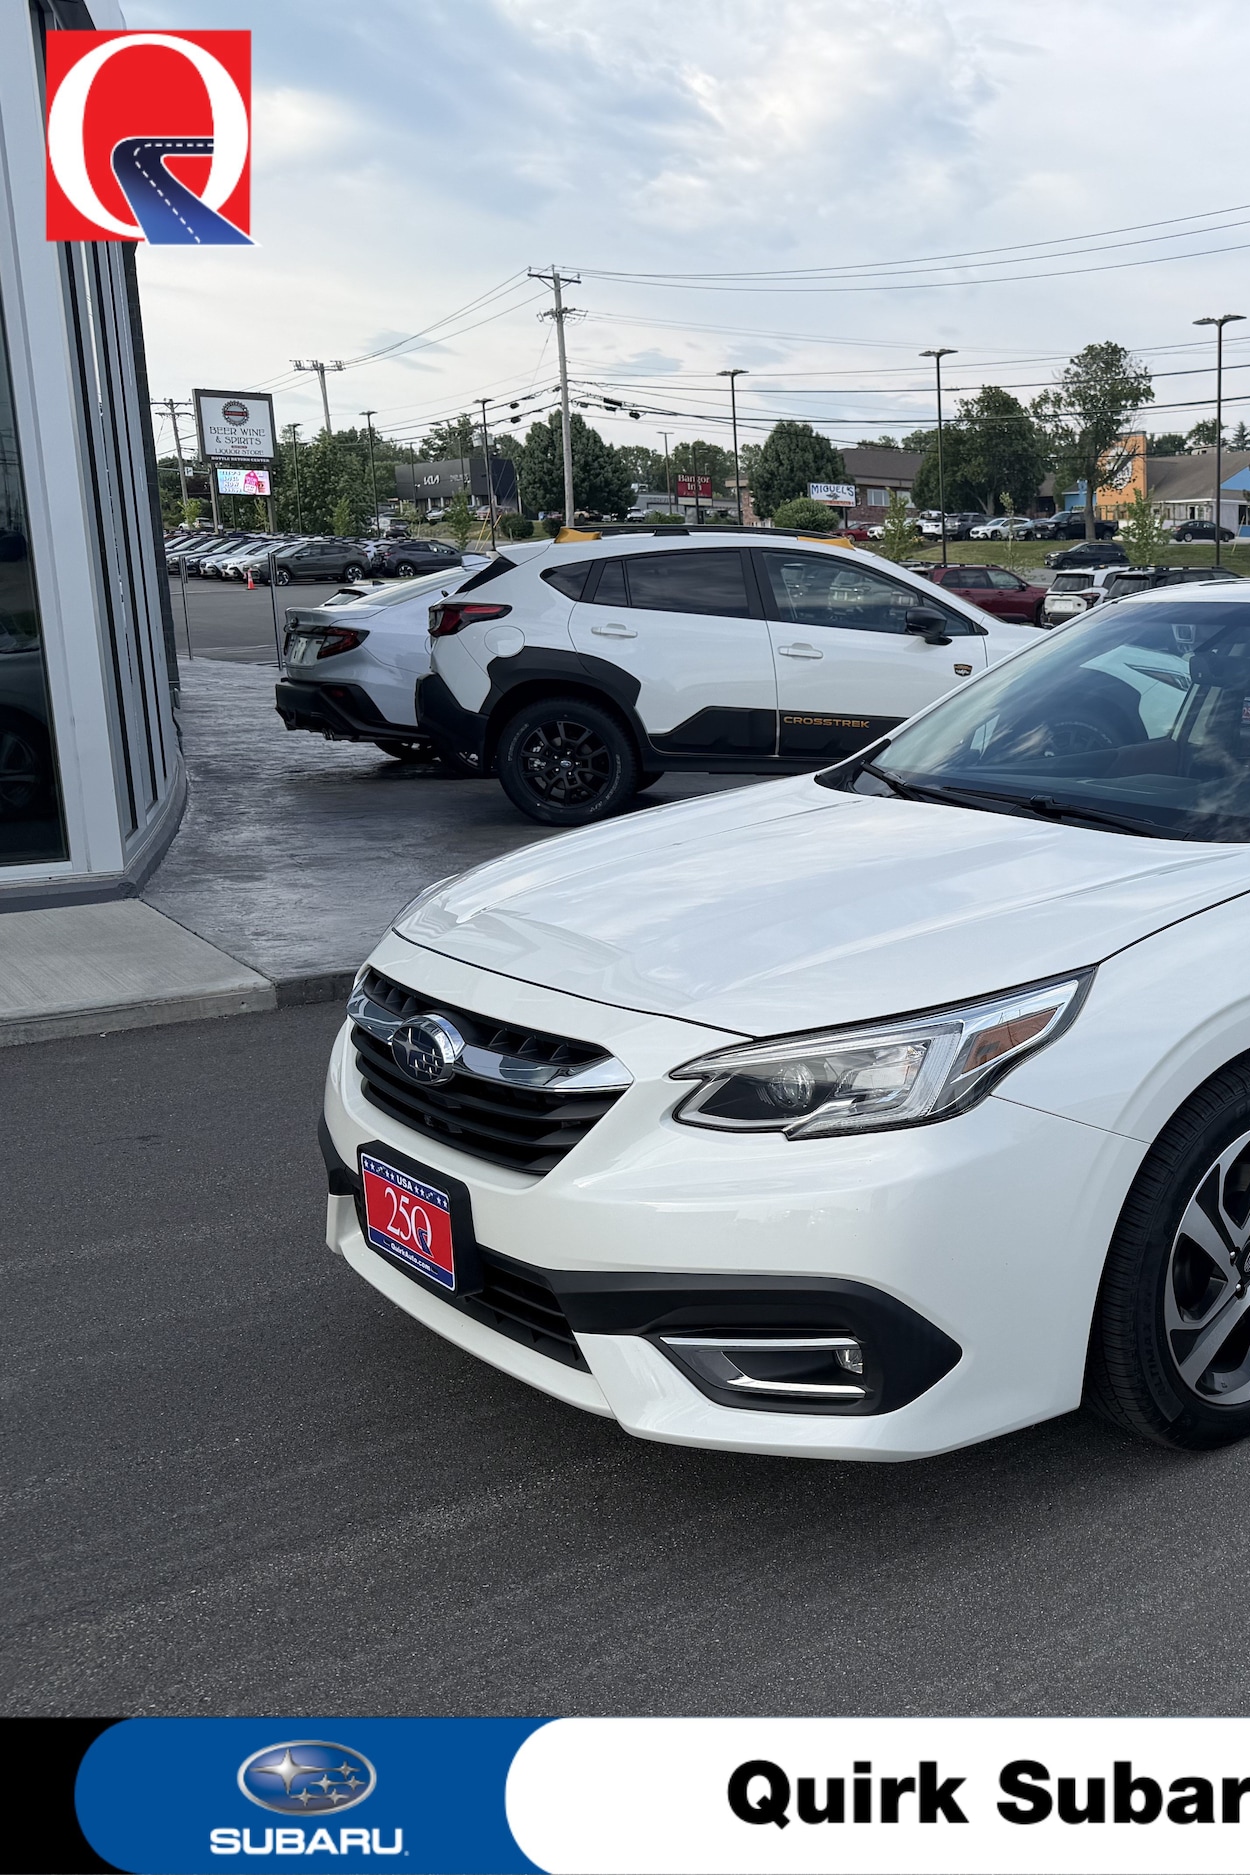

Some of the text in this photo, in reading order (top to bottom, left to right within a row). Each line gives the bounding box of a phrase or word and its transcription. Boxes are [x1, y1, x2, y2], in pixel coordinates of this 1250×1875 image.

[209, 426, 266, 437] BEER WINE
[224, 437, 262, 445] SPIRITS
[423, 474, 440, 485] KIA
[678, 474, 710, 484] Bangor
[811, 484, 854, 497] MIGUEL'S
[783, 716, 871, 728] CROSSTREK
[396, 1174, 413, 1191] USA
[390, 1242, 431, 1271] QuirkAuto.com
